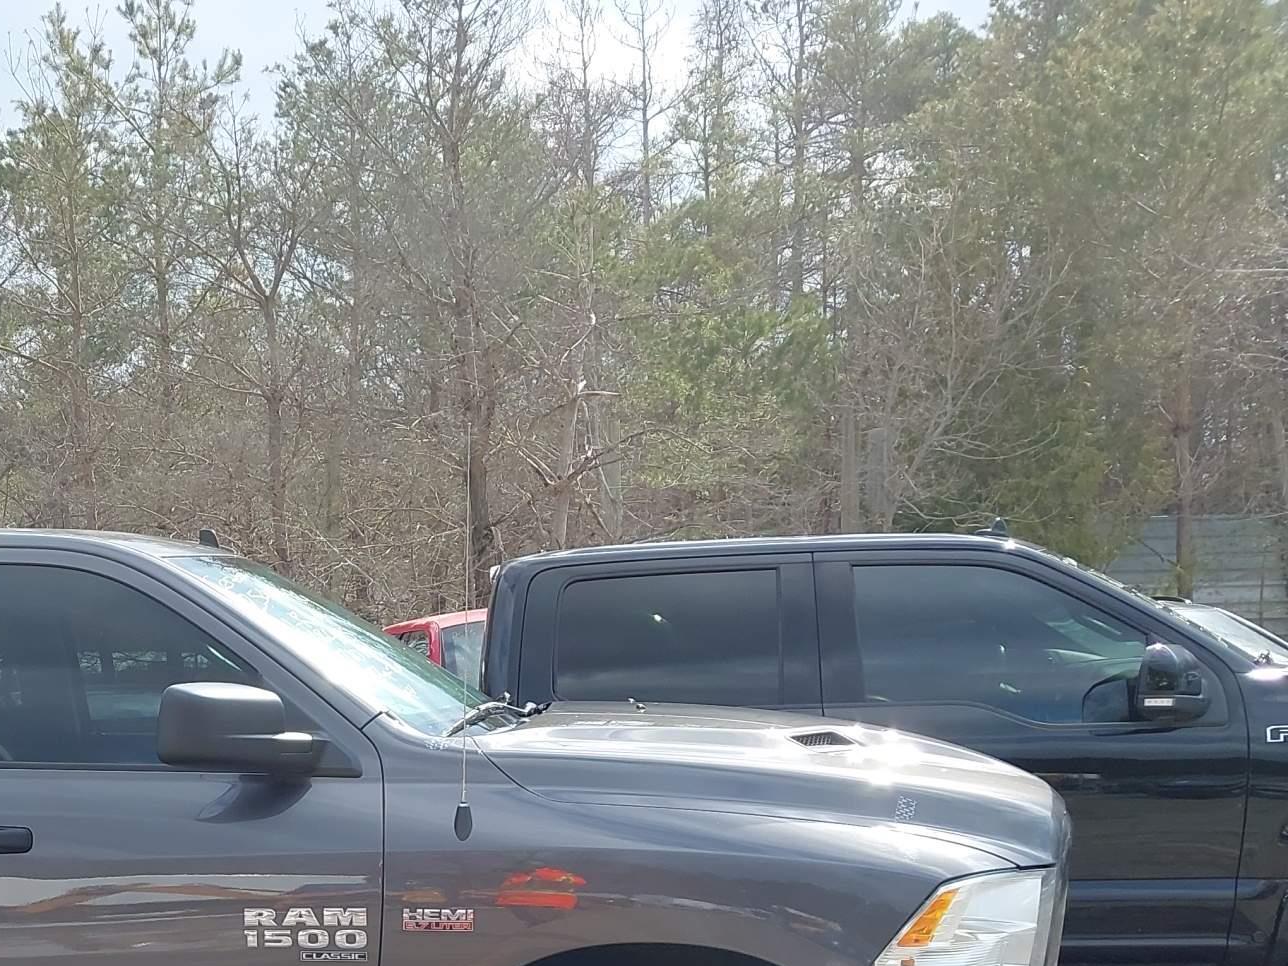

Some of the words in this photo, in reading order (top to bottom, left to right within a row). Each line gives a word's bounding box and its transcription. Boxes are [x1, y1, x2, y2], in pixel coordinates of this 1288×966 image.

[243, 907, 368, 927] RAM
[402, 908, 474, 921] HEMI
[405, 921, 428, 930] 5.7
[430, 921, 472, 930] LITER
[243, 929, 368, 949] 1500
[302, 952, 366, 960] CLASSIC
